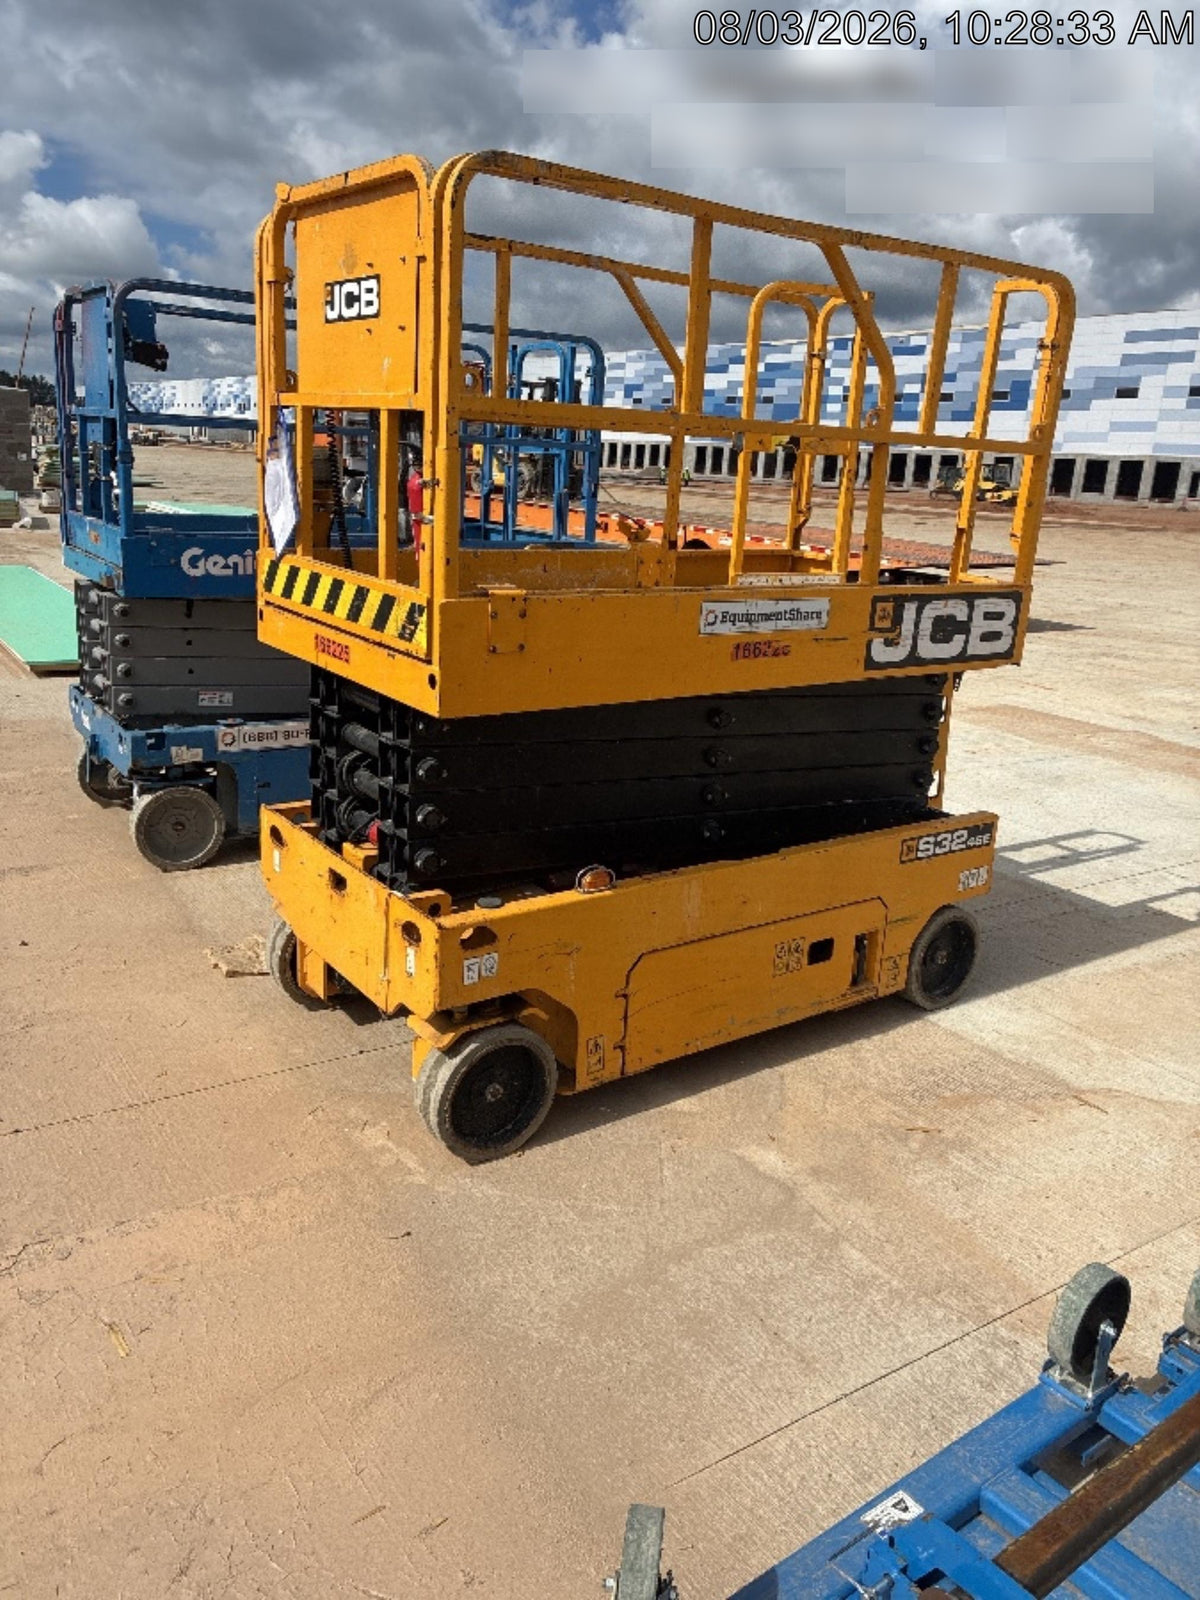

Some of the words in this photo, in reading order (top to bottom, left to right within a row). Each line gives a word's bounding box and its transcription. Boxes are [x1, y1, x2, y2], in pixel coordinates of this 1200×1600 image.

[325, 279, 380, 320] JCB
[181, 547, 257, 577] Geni
[719, 608, 822, 626] EquipmentShare
[870, 598, 1016, 663] JCB
